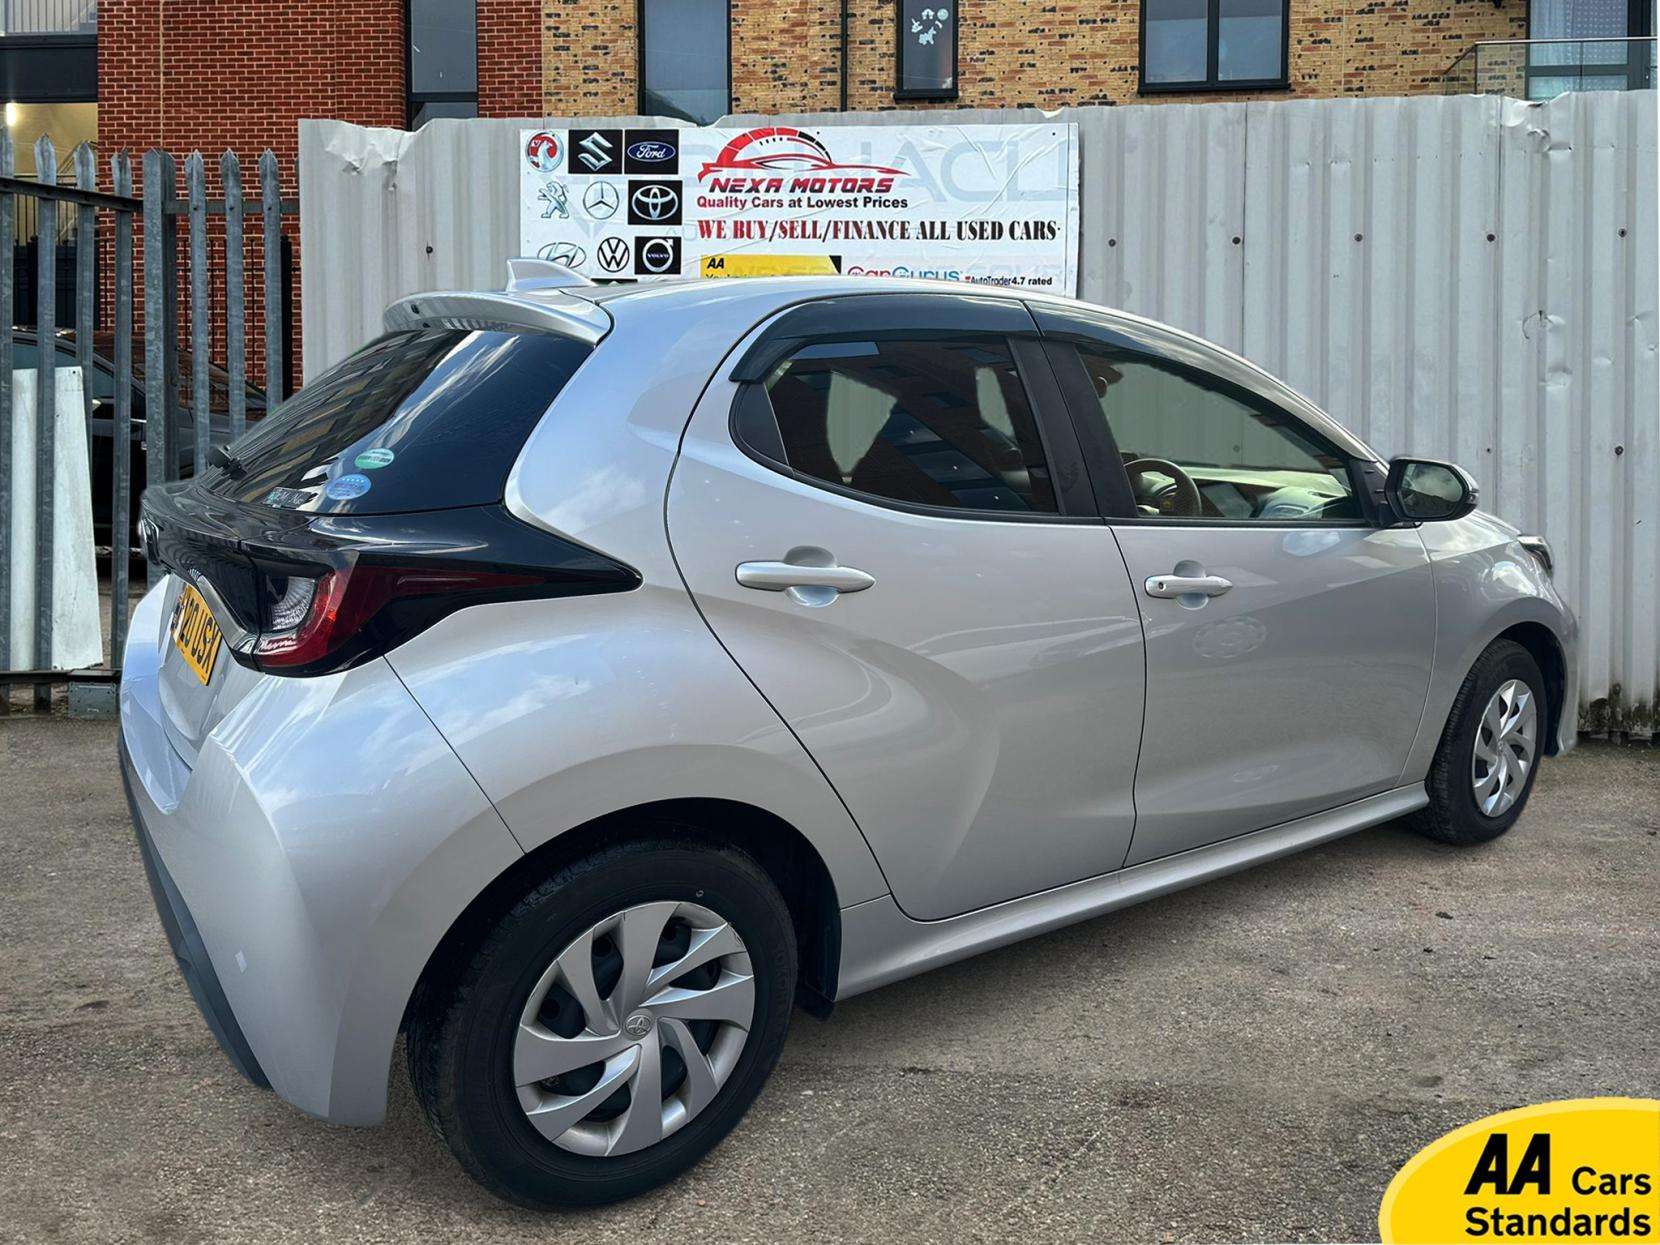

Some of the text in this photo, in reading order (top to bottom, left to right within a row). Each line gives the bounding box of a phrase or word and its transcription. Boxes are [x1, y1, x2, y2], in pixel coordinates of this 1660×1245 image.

[636, 143, 666, 159] Ford
[709, 178, 894, 193] NEXA MOTORS
[697, 196, 909, 211] Quality Cars at Lowest Prices
[697, 220, 727, 240] WE
[916, 220, 950, 240] ALL
[957, 220, 1004, 240] USED
[1009, 220, 1057, 240] CARS
[706, 257, 725, 269] AA
[1011, 276, 1026, 286] 4.7
[1028, 276, 1053, 286] rated
